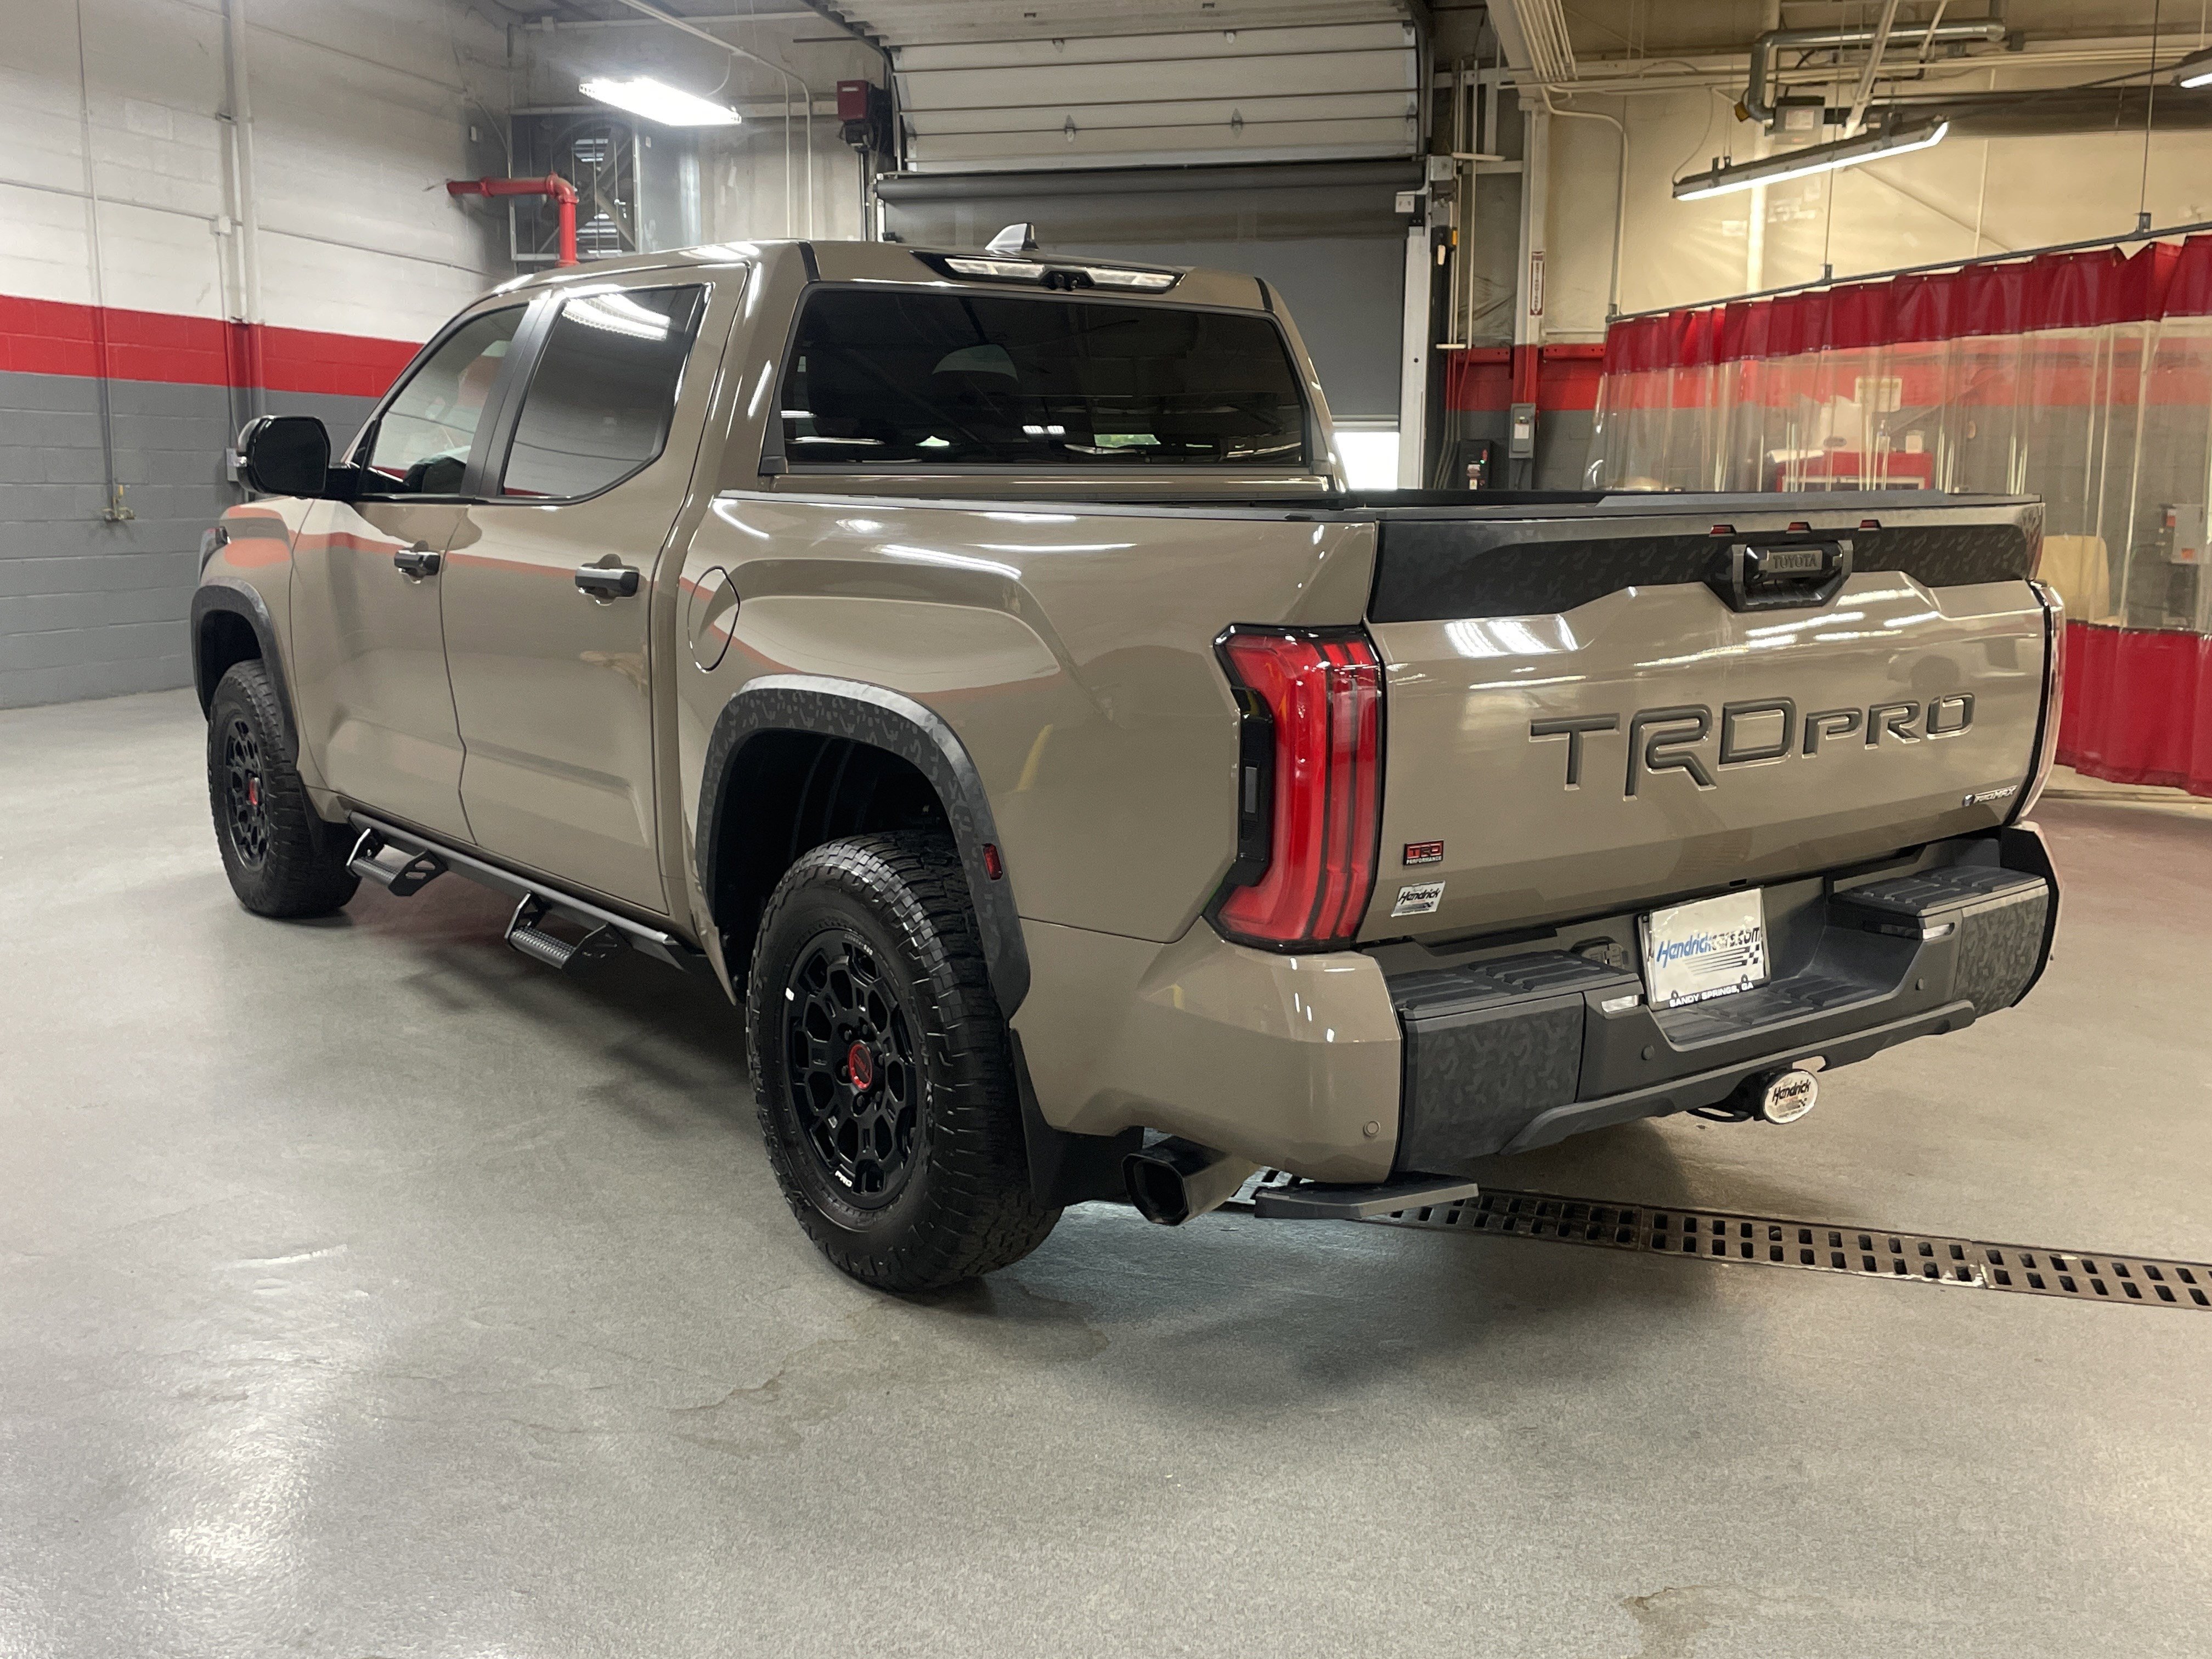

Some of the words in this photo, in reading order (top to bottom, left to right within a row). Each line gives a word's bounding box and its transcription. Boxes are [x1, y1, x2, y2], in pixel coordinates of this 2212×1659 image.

[1773, 553, 1818, 569] TOYOTA
[1529, 696, 1797, 801] TRD
[1802, 691, 1975, 760] PRO
[1398, 888, 1441, 905] Hendrick
[1669, 992, 1700, 1007] SANDY
[1701, 985, 1740, 1000] SPRINGS,
[1741, 981, 1754, 991] GA
[1771, 1079, 1812, 1106] Hendrick
